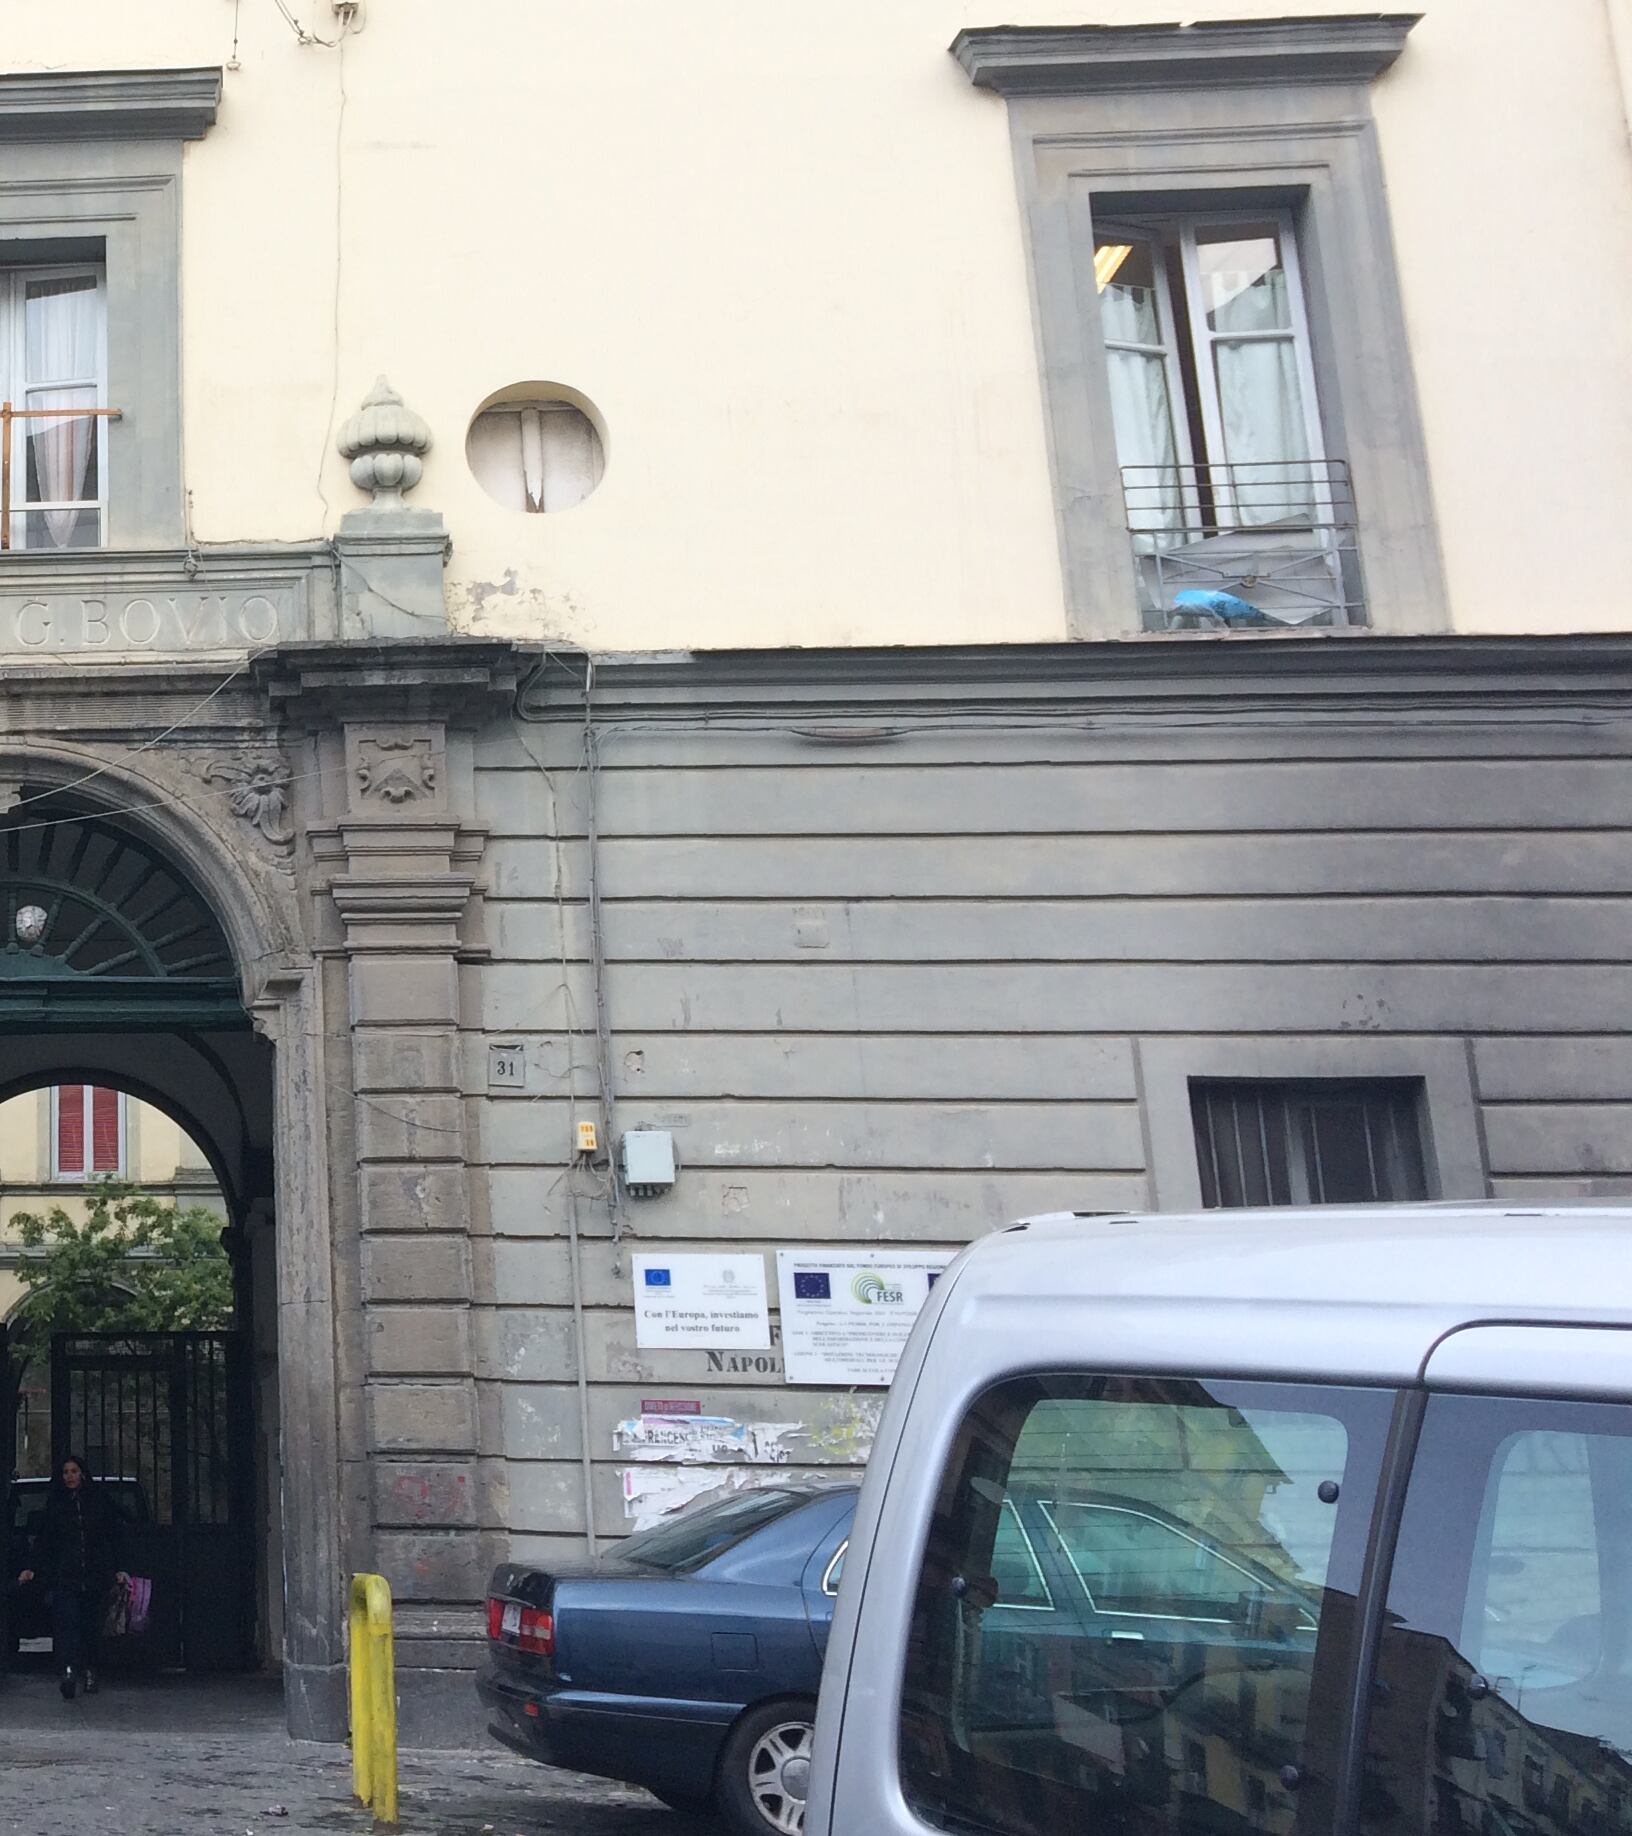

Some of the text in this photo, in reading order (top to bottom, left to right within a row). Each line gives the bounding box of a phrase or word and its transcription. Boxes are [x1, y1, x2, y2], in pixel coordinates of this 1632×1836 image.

[81, 596, 278, 646] BOVIO
[497, 1061, 515, 1076] 31
[877, 1291, 903, 1302] FESR
[644, 1310, 663, 1319] Con
[710, 1310, 759, 1319] investiamo
[665, 1324, 678, 1332] nel
[711, 1324, 740, 1332] futuro
